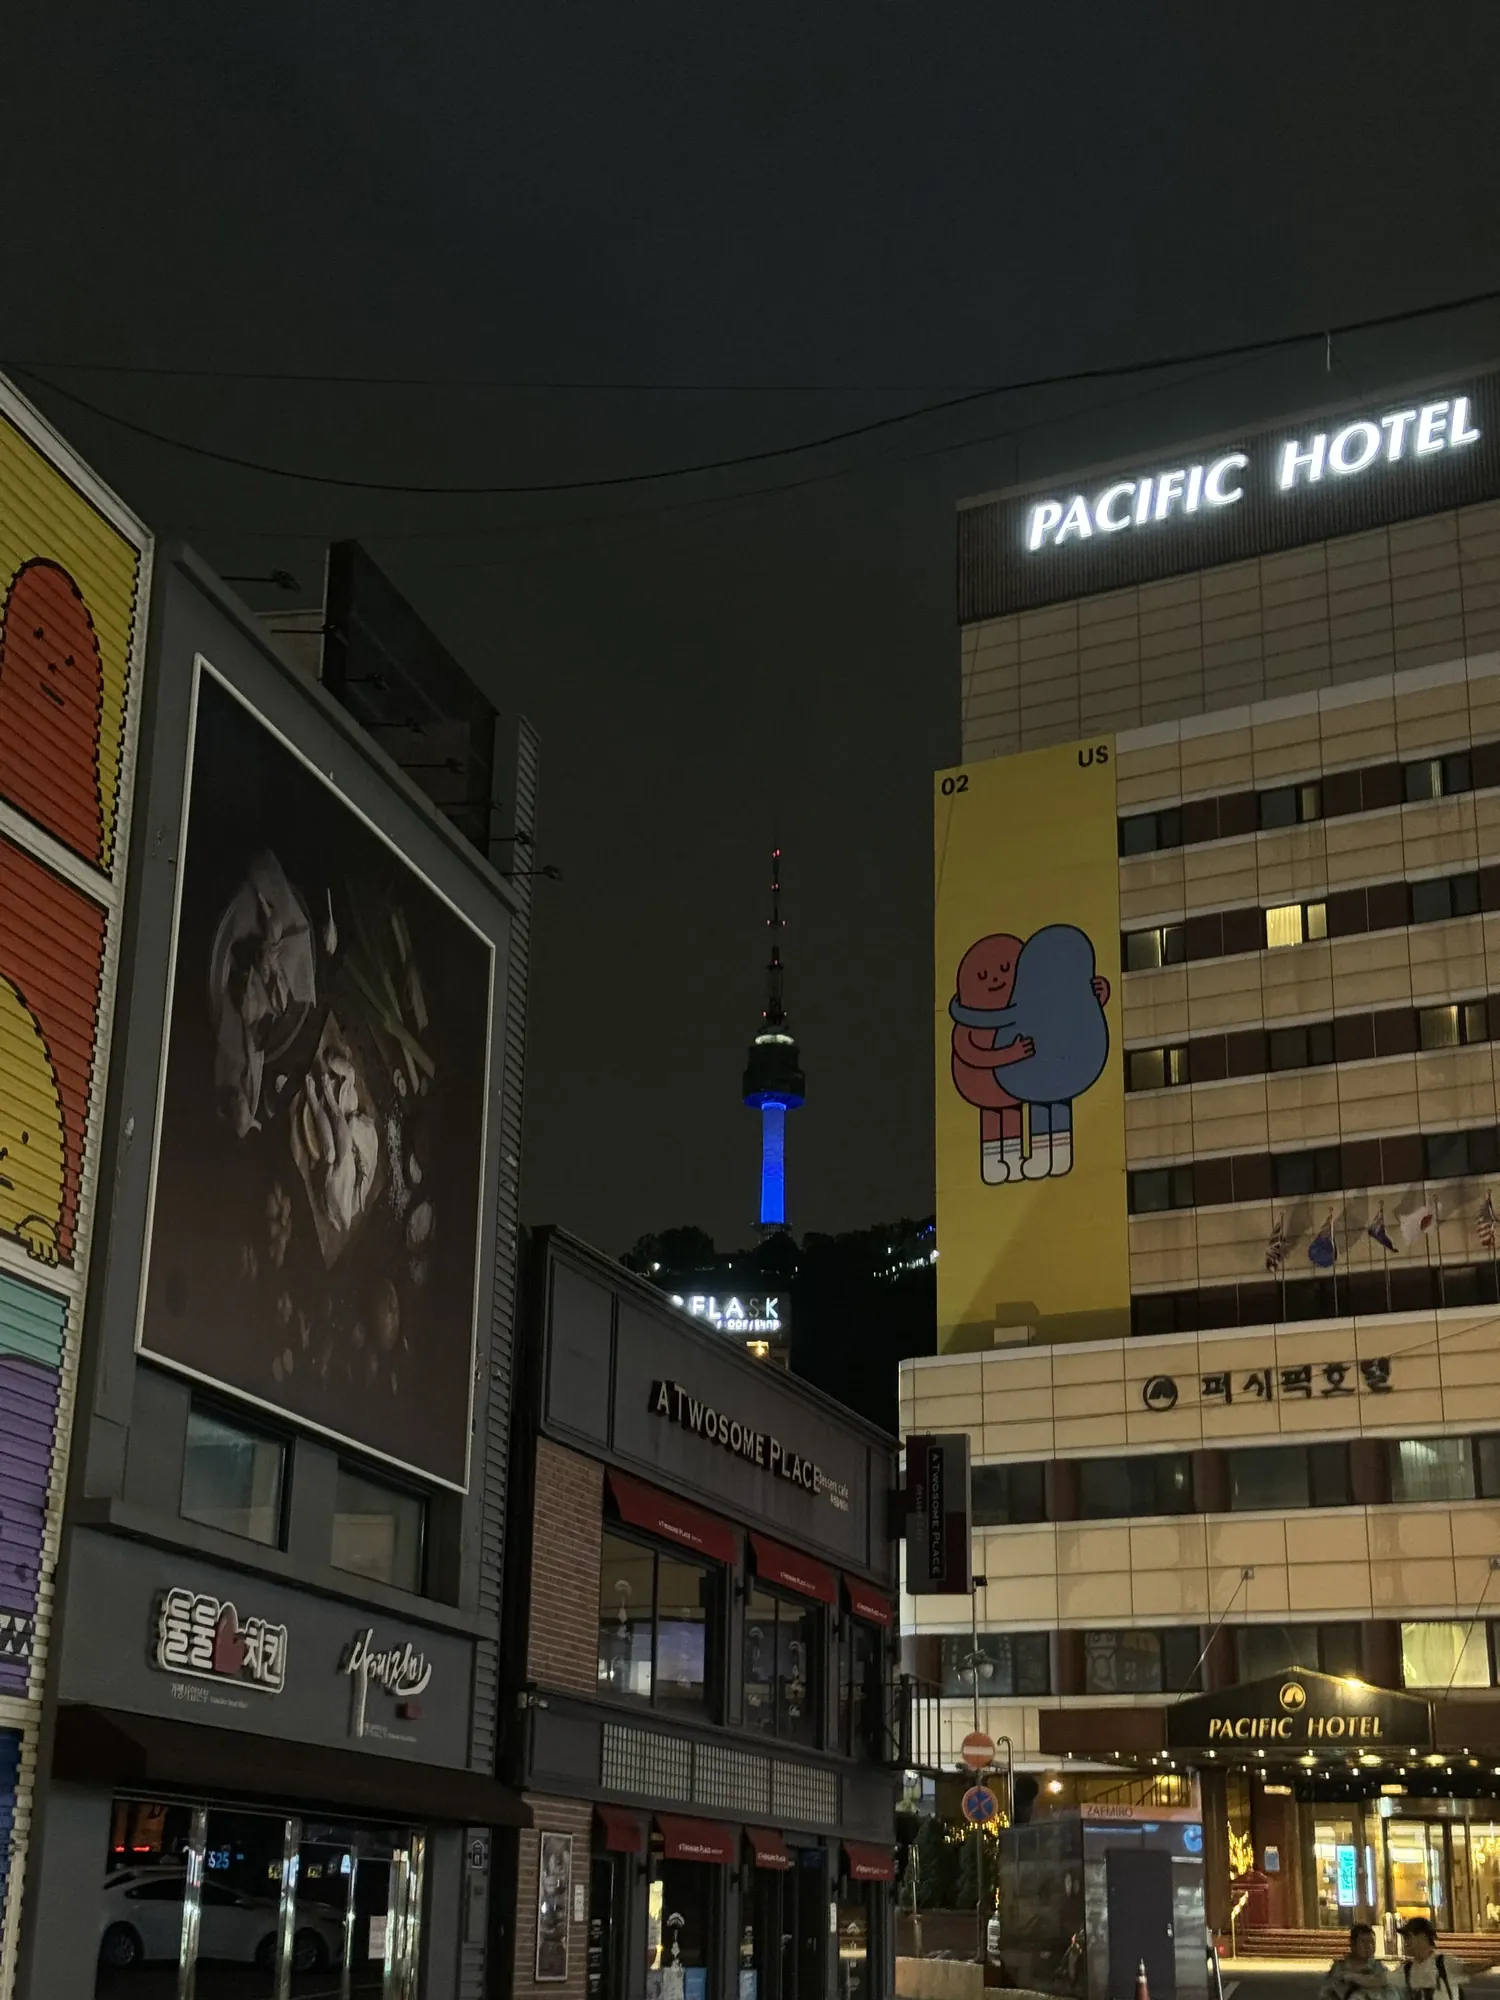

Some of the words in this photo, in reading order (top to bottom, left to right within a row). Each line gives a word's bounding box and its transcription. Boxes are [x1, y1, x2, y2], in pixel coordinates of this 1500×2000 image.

[1026, 453, 1249, 552] PACIFIC
[1279, 396, 1481, 491] HOTEL
[1077, 746, 1109, 769] US
[940, 774, 970, 796] 02
[692, 1296, 779, 1320] FLASK
[1201, 1357, 1393, 1406] 퍼시픽호텔
[656, 1381, 670, 1415] A
[674, 1384, 765, 1466] TWOSOME
[769, 1435, 821, 1494] PLACE
[931, 1453, 941, 1462] A
[931, 1464, 941, 1528] TWOSOME
[931, 1532, 941, 1575] PLACE
[1208, 1716, 1293, 1740] PACIFIC
[1307, 1716, 1384, 1739] HOTEL
